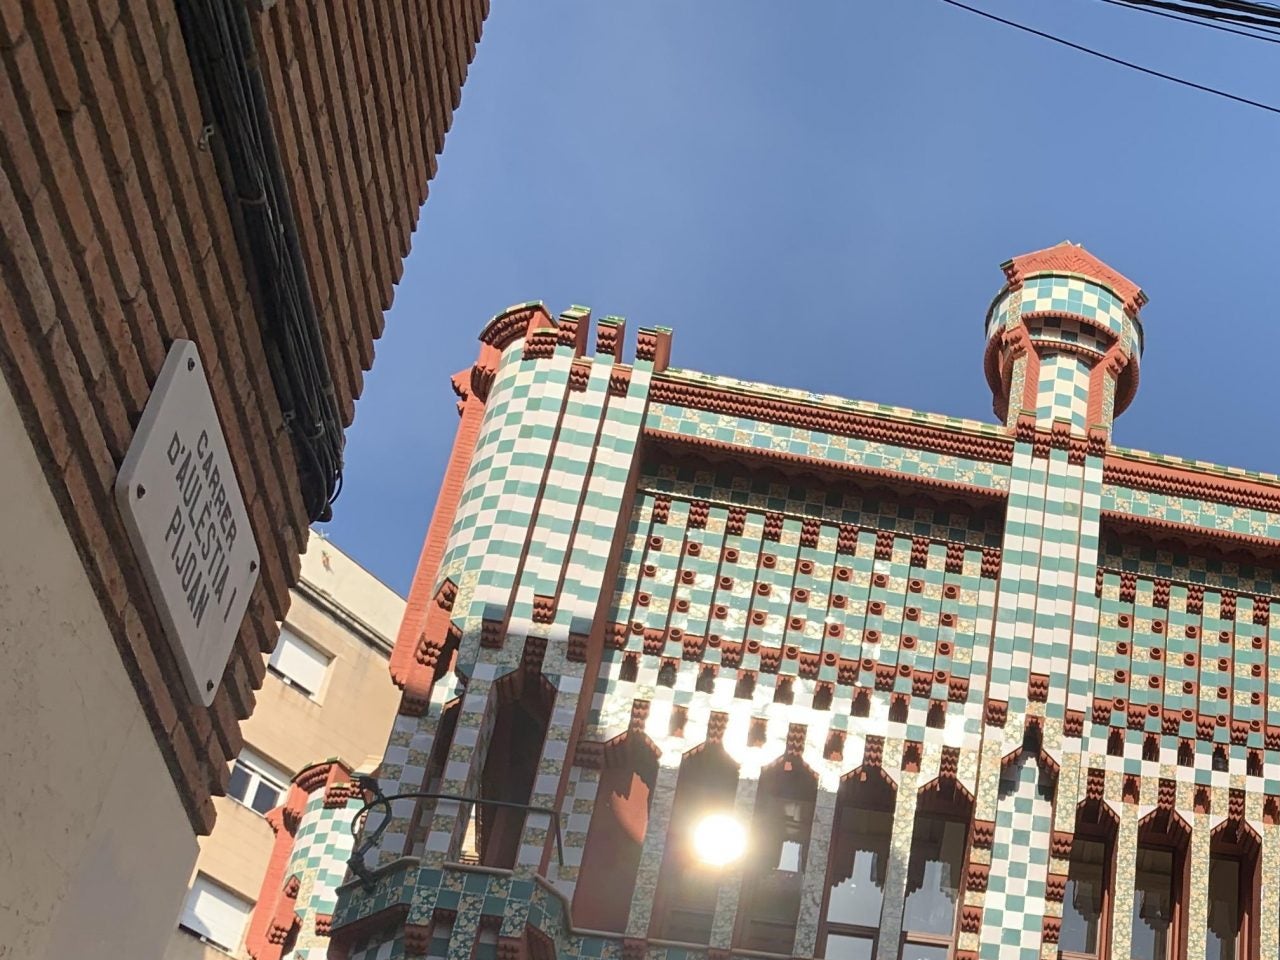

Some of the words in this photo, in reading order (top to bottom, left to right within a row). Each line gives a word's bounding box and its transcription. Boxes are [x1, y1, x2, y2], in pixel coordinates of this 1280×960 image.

[197, 429, 237, 552] CARRER
[165, 505, 210, 629] PIJOAN
[224, 587, 237, 623] I
